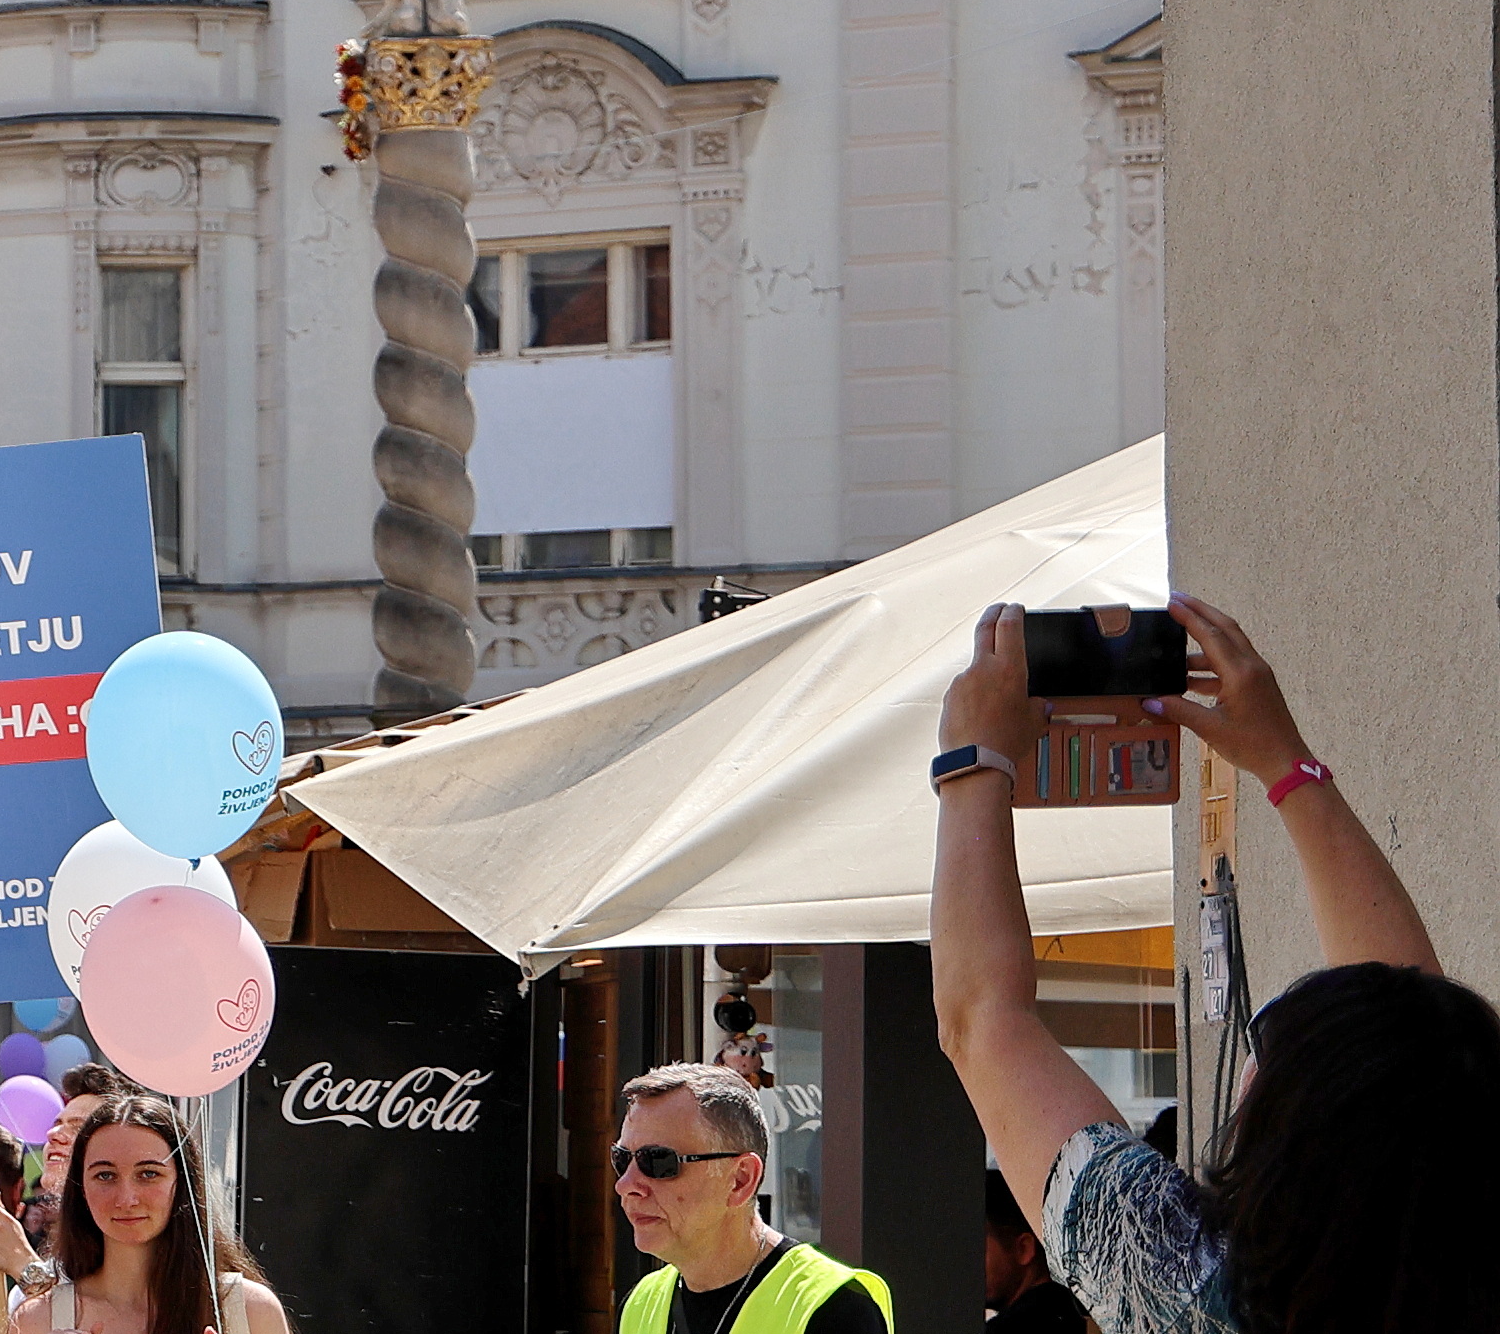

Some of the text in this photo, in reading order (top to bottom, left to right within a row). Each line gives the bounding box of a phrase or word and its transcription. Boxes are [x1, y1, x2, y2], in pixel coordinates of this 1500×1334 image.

[222, 781, 267, 801] POHOD
[213, 1033, 258, 1061] POHOD
[279, 1061, 494, 1134] Coca-Cola
